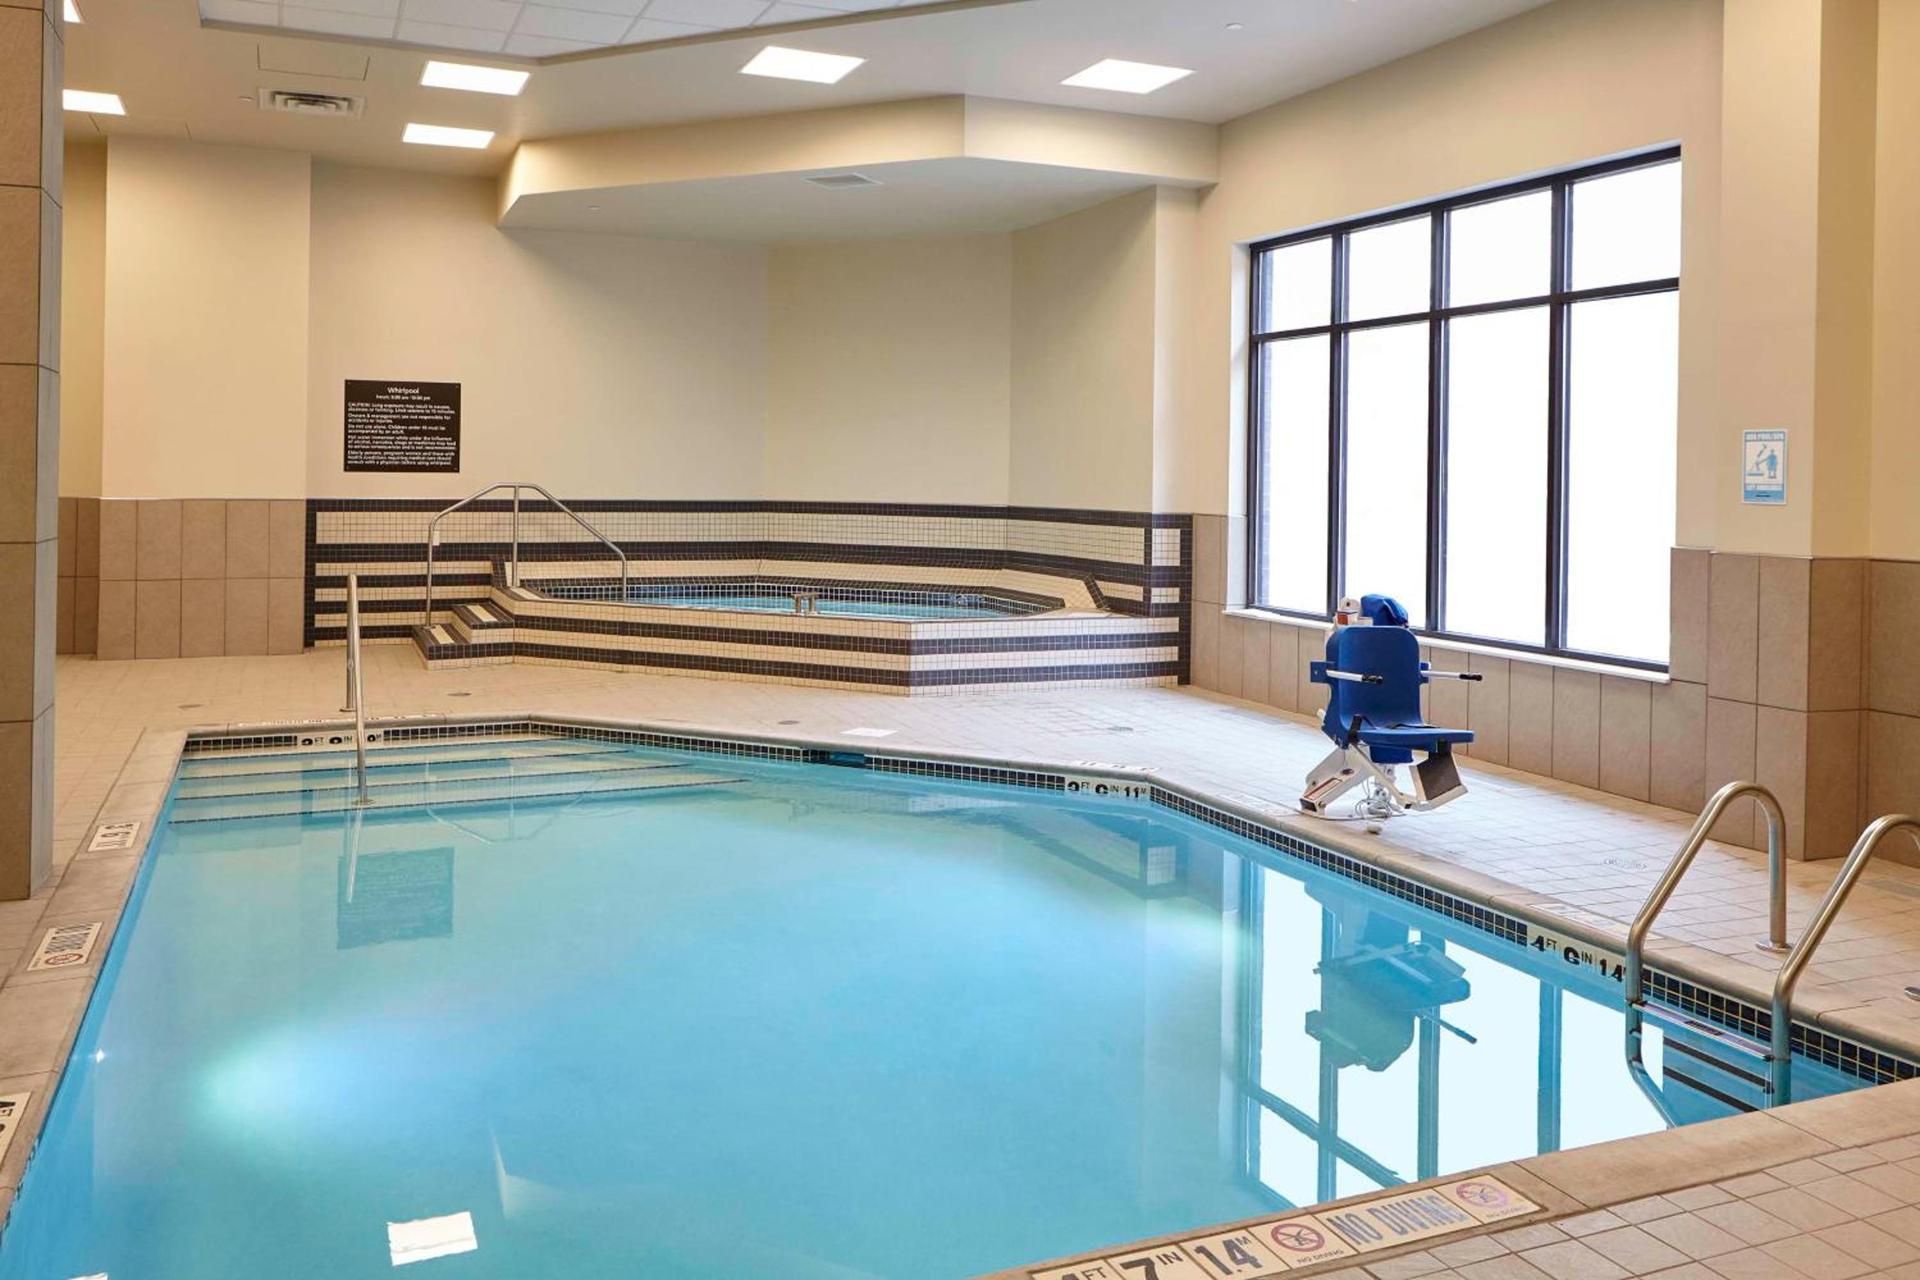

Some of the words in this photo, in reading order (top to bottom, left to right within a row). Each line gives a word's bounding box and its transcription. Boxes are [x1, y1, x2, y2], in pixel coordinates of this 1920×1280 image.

[387, 387, 420, 395] Whirlpool
[1326, 1211, 1384, 1246] NO
[1365, 1194, 1470, 1237] DIVING
